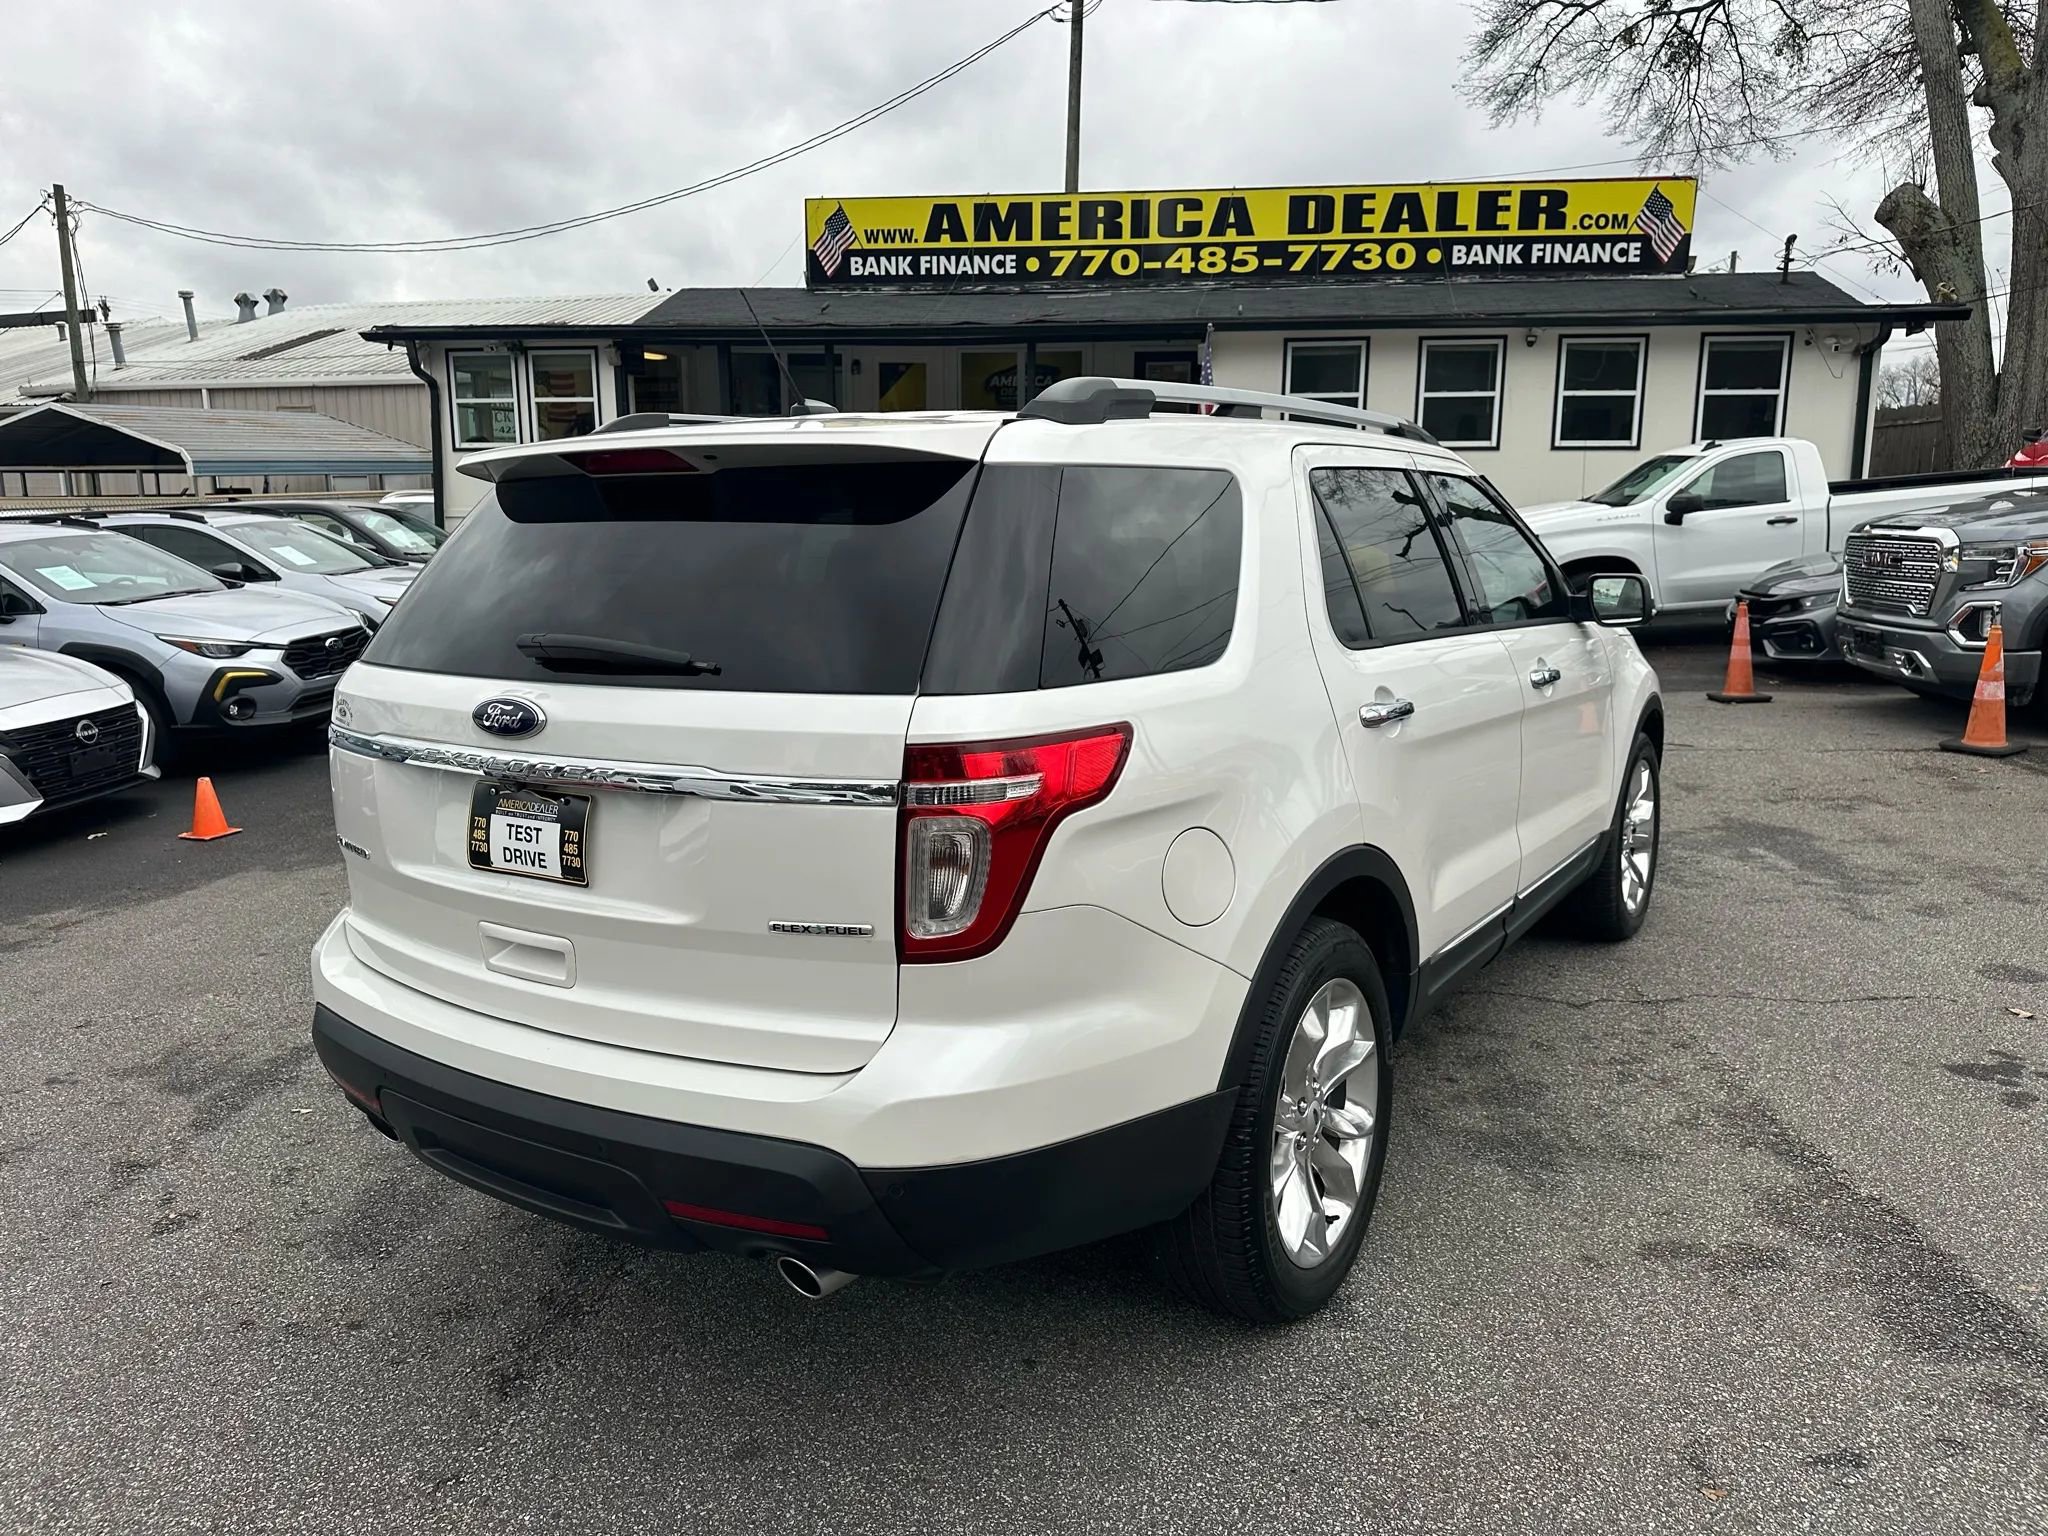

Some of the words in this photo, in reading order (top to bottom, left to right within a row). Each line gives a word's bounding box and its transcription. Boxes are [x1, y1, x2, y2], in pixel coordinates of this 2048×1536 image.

[850, 256, 913, 276] BANK
[920, 253, 1017, 275] FINANCE
[1048, 242, 1417, 278] 770-485-7730
[1451, 243, 1523, 266] BANK
[1530, 241, 1641, 264] FINANCE
[482, 702, 524, 729] Ford
[474, 816, 487, 828] 770
[473, 829, 486, 841] 485
[506, 823, 543, 845] TEST
[564, 830, 579, 842] 770
[471, 841, 488, 853] 7730
[563, 843, 578, 855] 485
[503, 846, 548, 869] DRIVE
[561, 855, 581, 868] 7730
[772, 923, 813, 934] FLEX
[825, 926, 870, 936] FUEL
